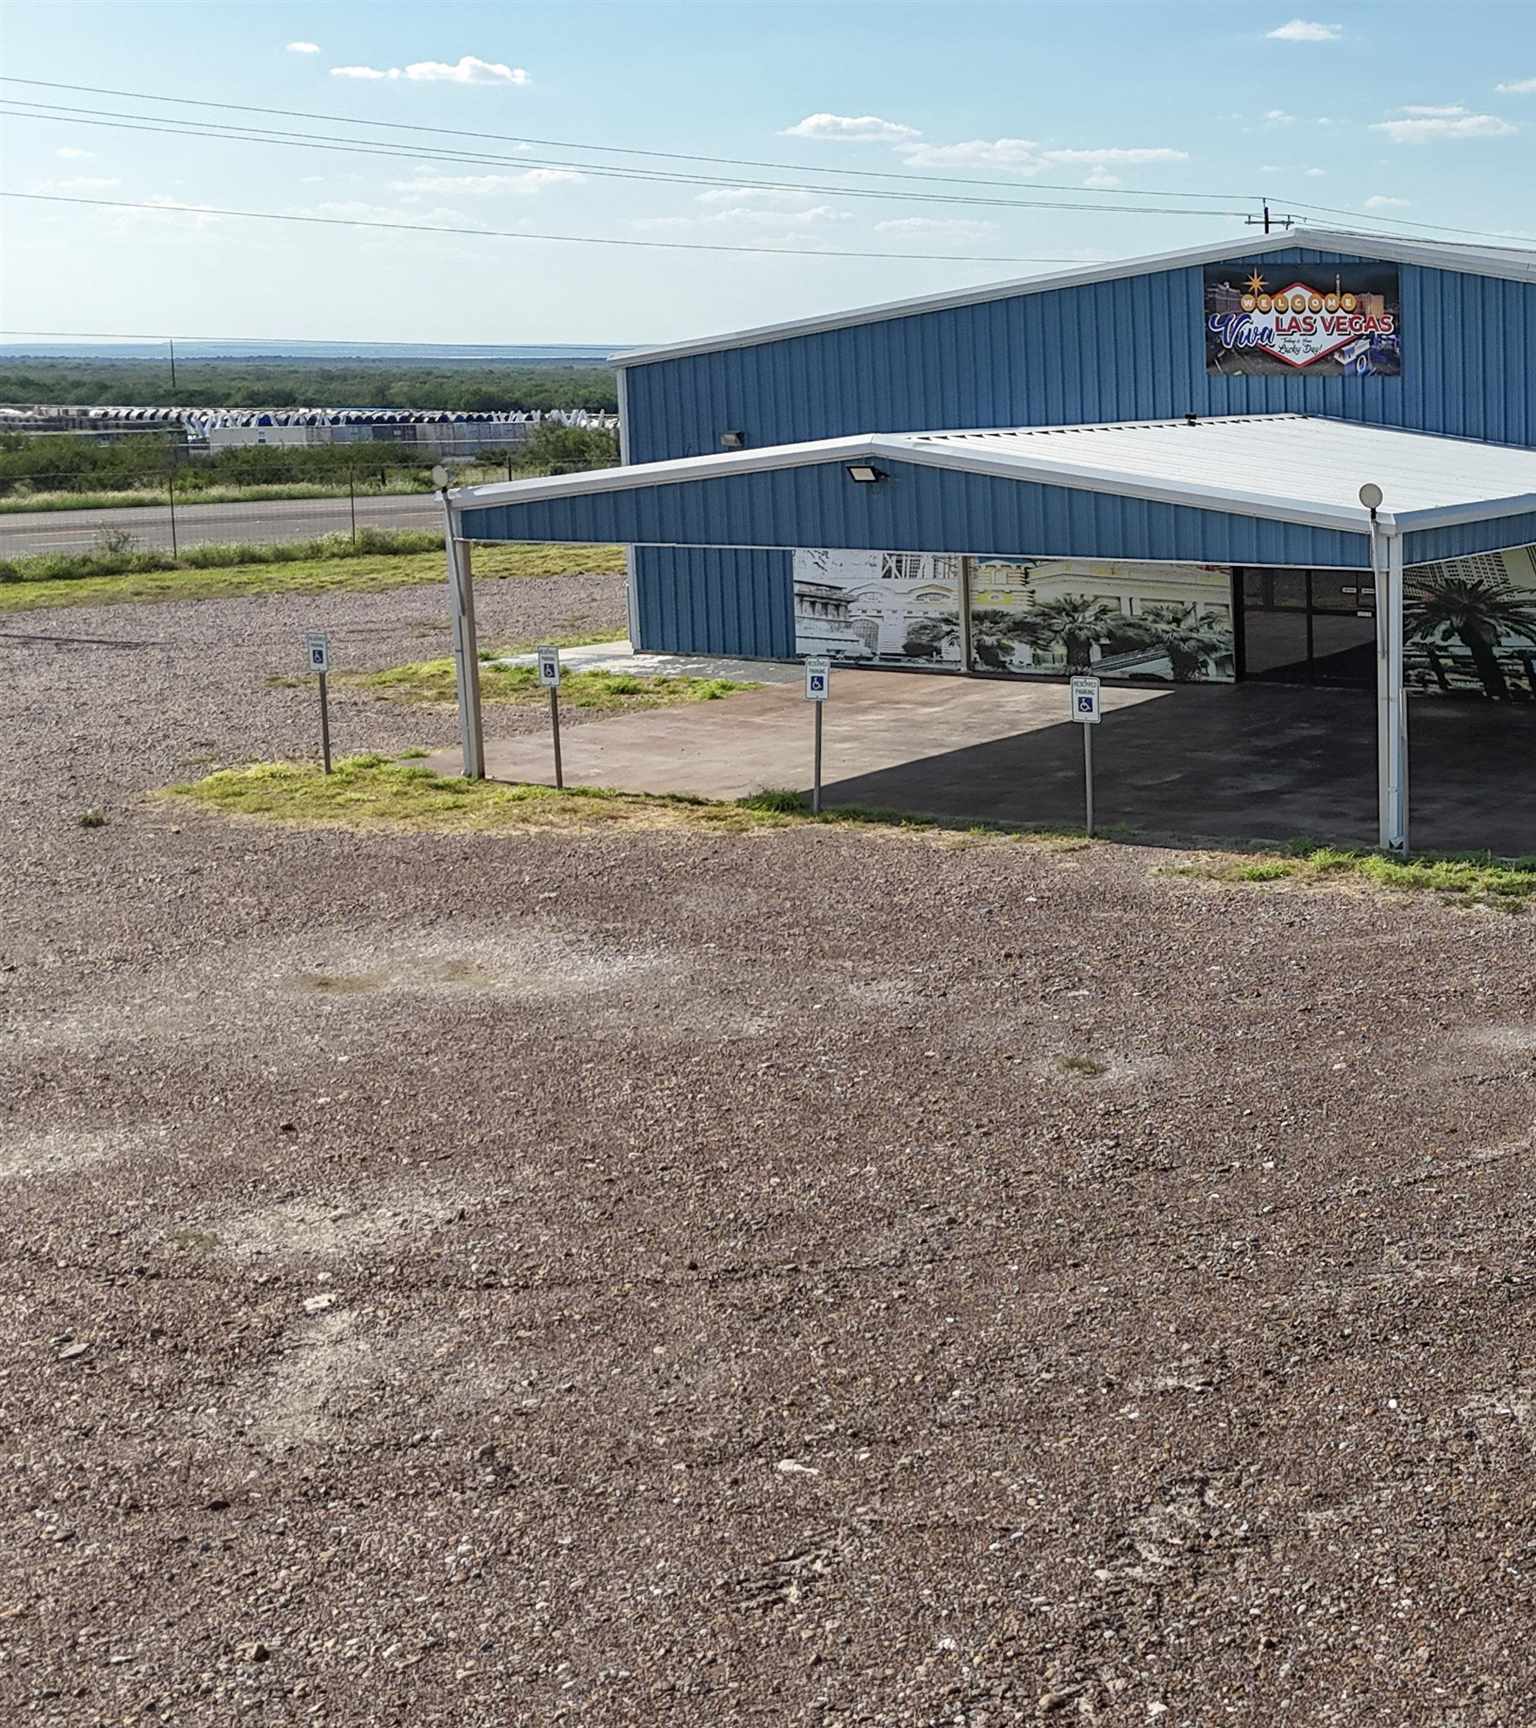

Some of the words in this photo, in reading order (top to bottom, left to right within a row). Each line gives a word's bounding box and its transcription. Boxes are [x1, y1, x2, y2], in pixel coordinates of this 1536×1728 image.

[1242, 296, 1354, 309] WELCOME
[1209, 313, 1275, 349] Viva
[1275, 316, 1316, 334] LAS
[1320, 315, 1393, 334] VEGAS
